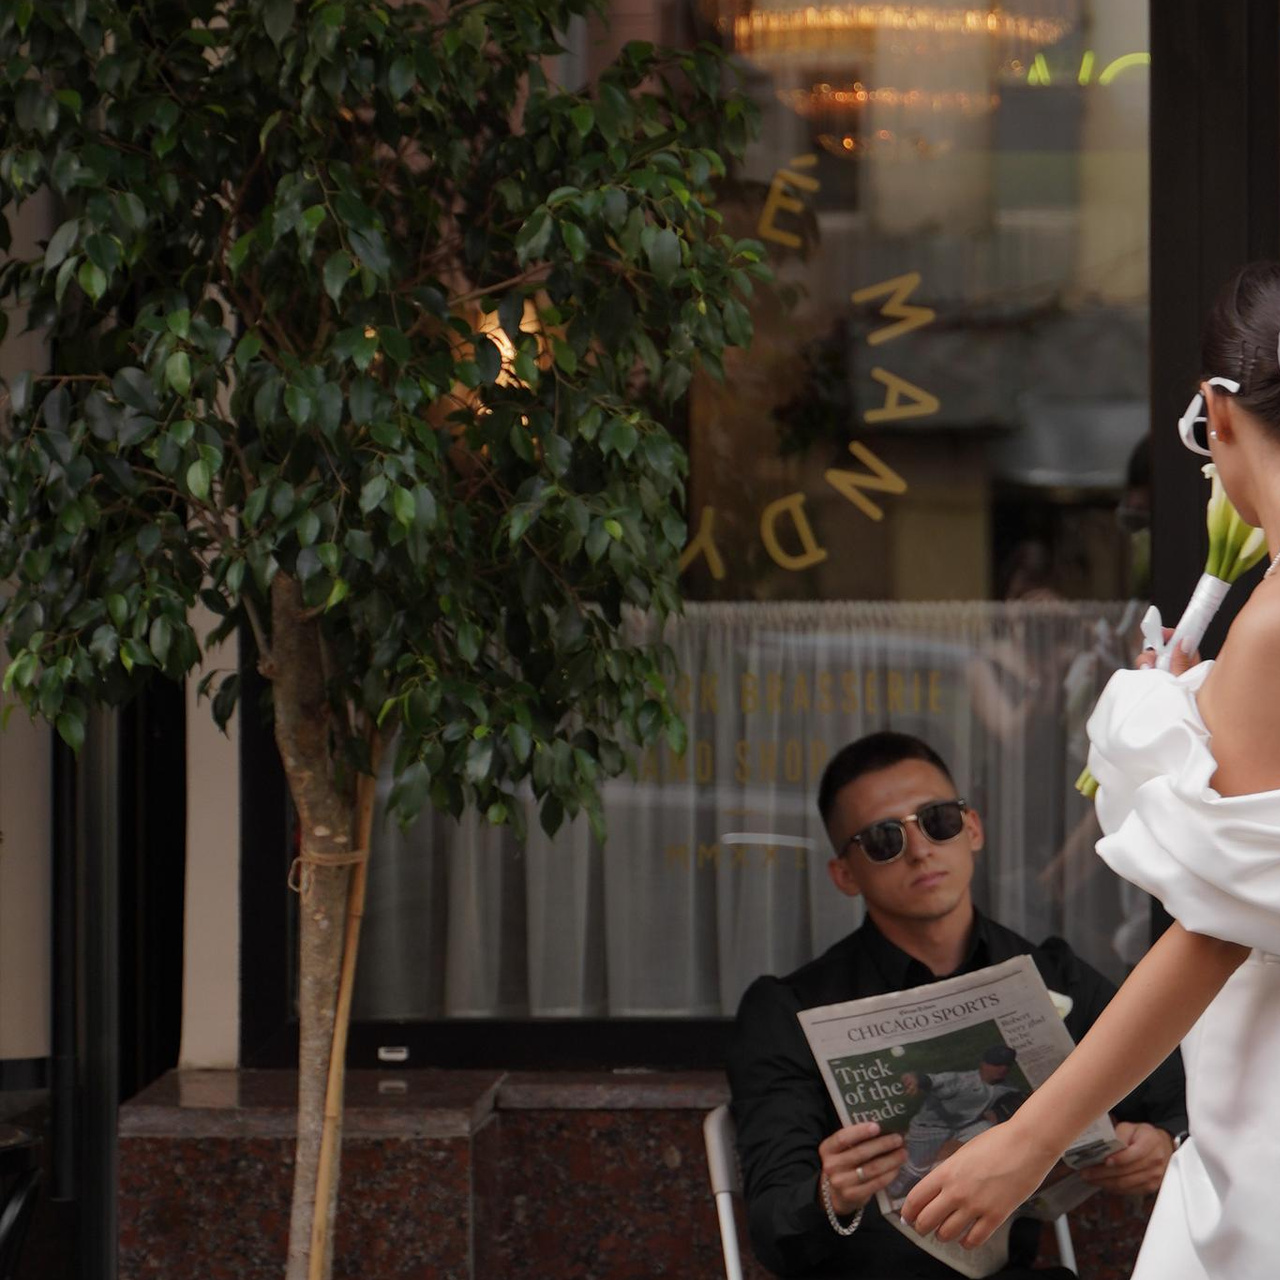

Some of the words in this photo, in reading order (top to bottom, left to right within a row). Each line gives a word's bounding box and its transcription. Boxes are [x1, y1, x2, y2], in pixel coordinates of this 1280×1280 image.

[740, 669, 943, 715] BRASSERIE
[735, 740, 829, 784] SHOP
[847, 1013, 930, 1043] CHICAGO
[931, 992, 1001, 1024] SPORTS
[834, 1058, 893, 1085] Trick
[844, 1083, 867, 1106] of
[869, 1080, 905, 1101] the
[852, 1100, 907, 1124] trade
